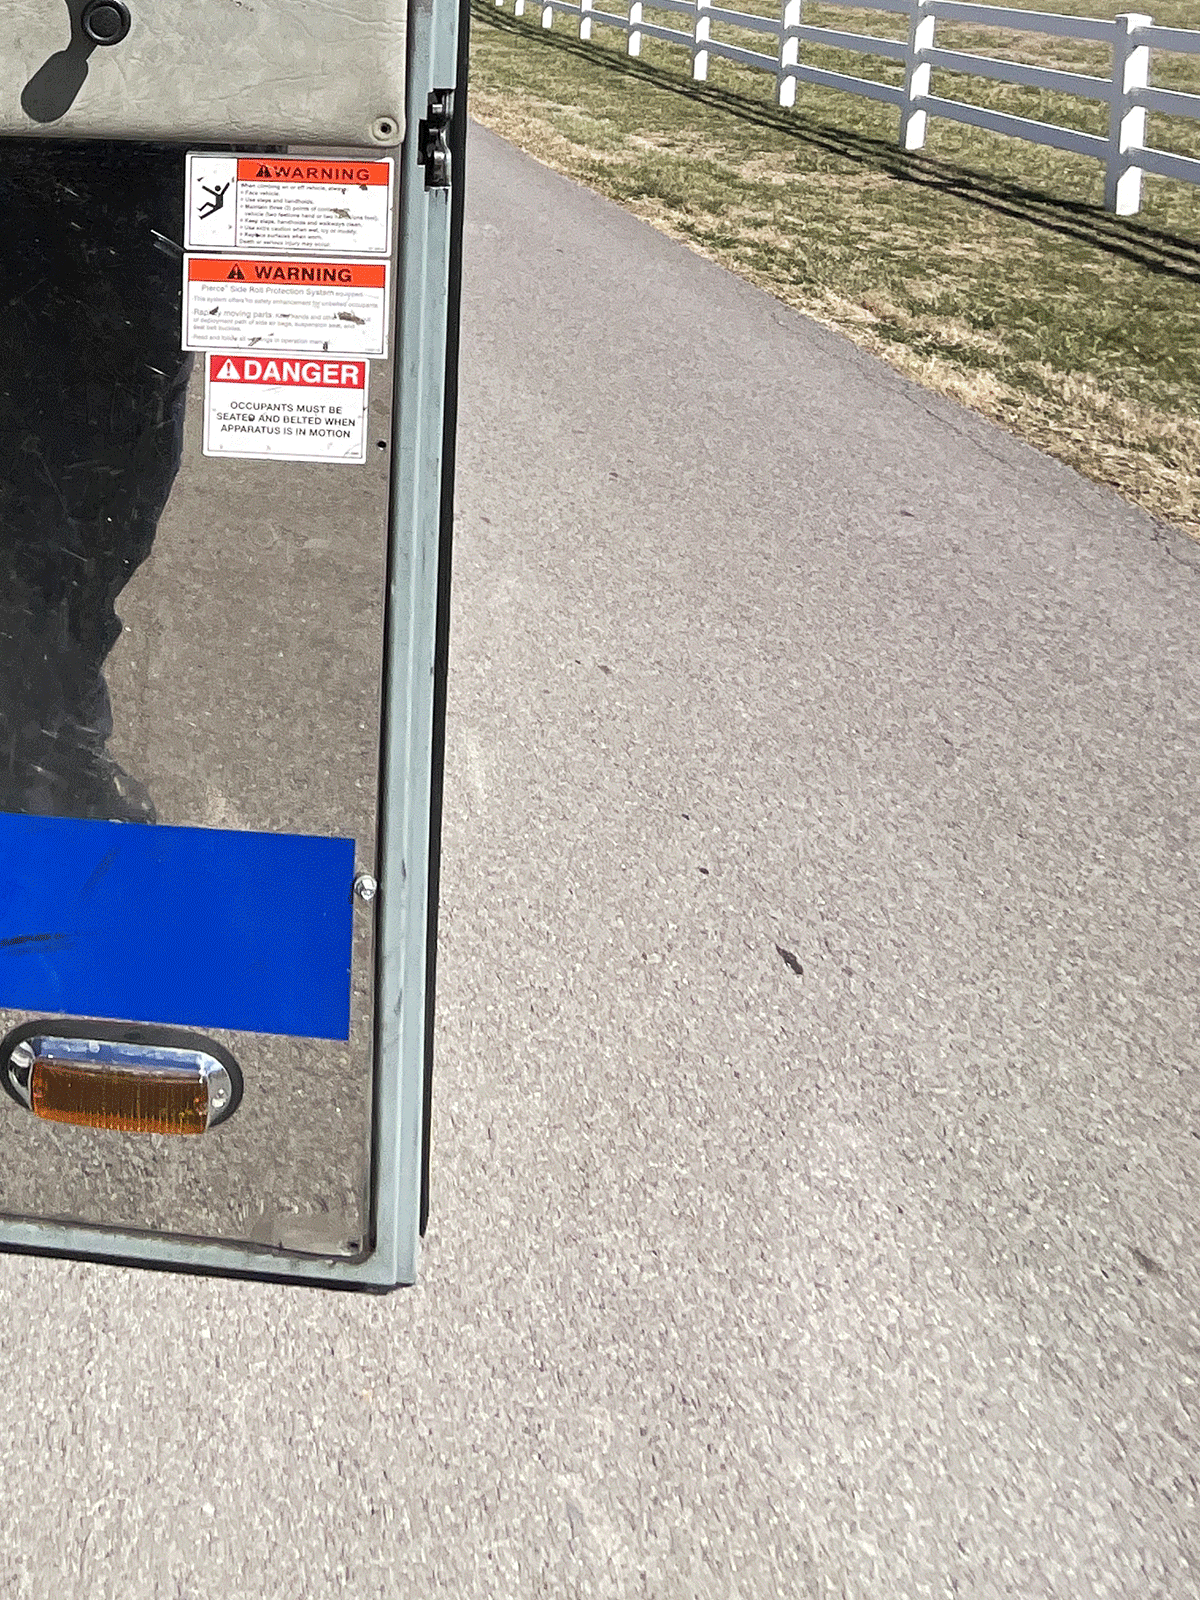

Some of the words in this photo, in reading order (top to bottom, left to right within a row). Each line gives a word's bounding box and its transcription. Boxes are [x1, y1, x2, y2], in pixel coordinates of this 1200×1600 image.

[274, 166, 370, 181] WARNING
[255, 265, 352, 283] WARNING
[230, 285, 248, 293] Side
[265, 287, 304, 295] Protection
[306, 288, 334, 297] System
[223, 310, 251, 319] moving
[243, 360, 360, 385] DANGER
[230, 401, 294, 413] OCCUPANTS
[296, 404, 325, 414] MUST
[328, 406, 343, 415] BE
[216, 412, 256, 422] SEATED
[258, 414, 280, 423] AND
[283, 415, 322, 425] BELTED
[325, 417, 356, 427] WHEN
[220, 424, 281, 435] APPARATUS
[283, 427, 293, 436] IS
[295, 427, 307, 436] IN
[309, 428, 351, 438] MOTION
